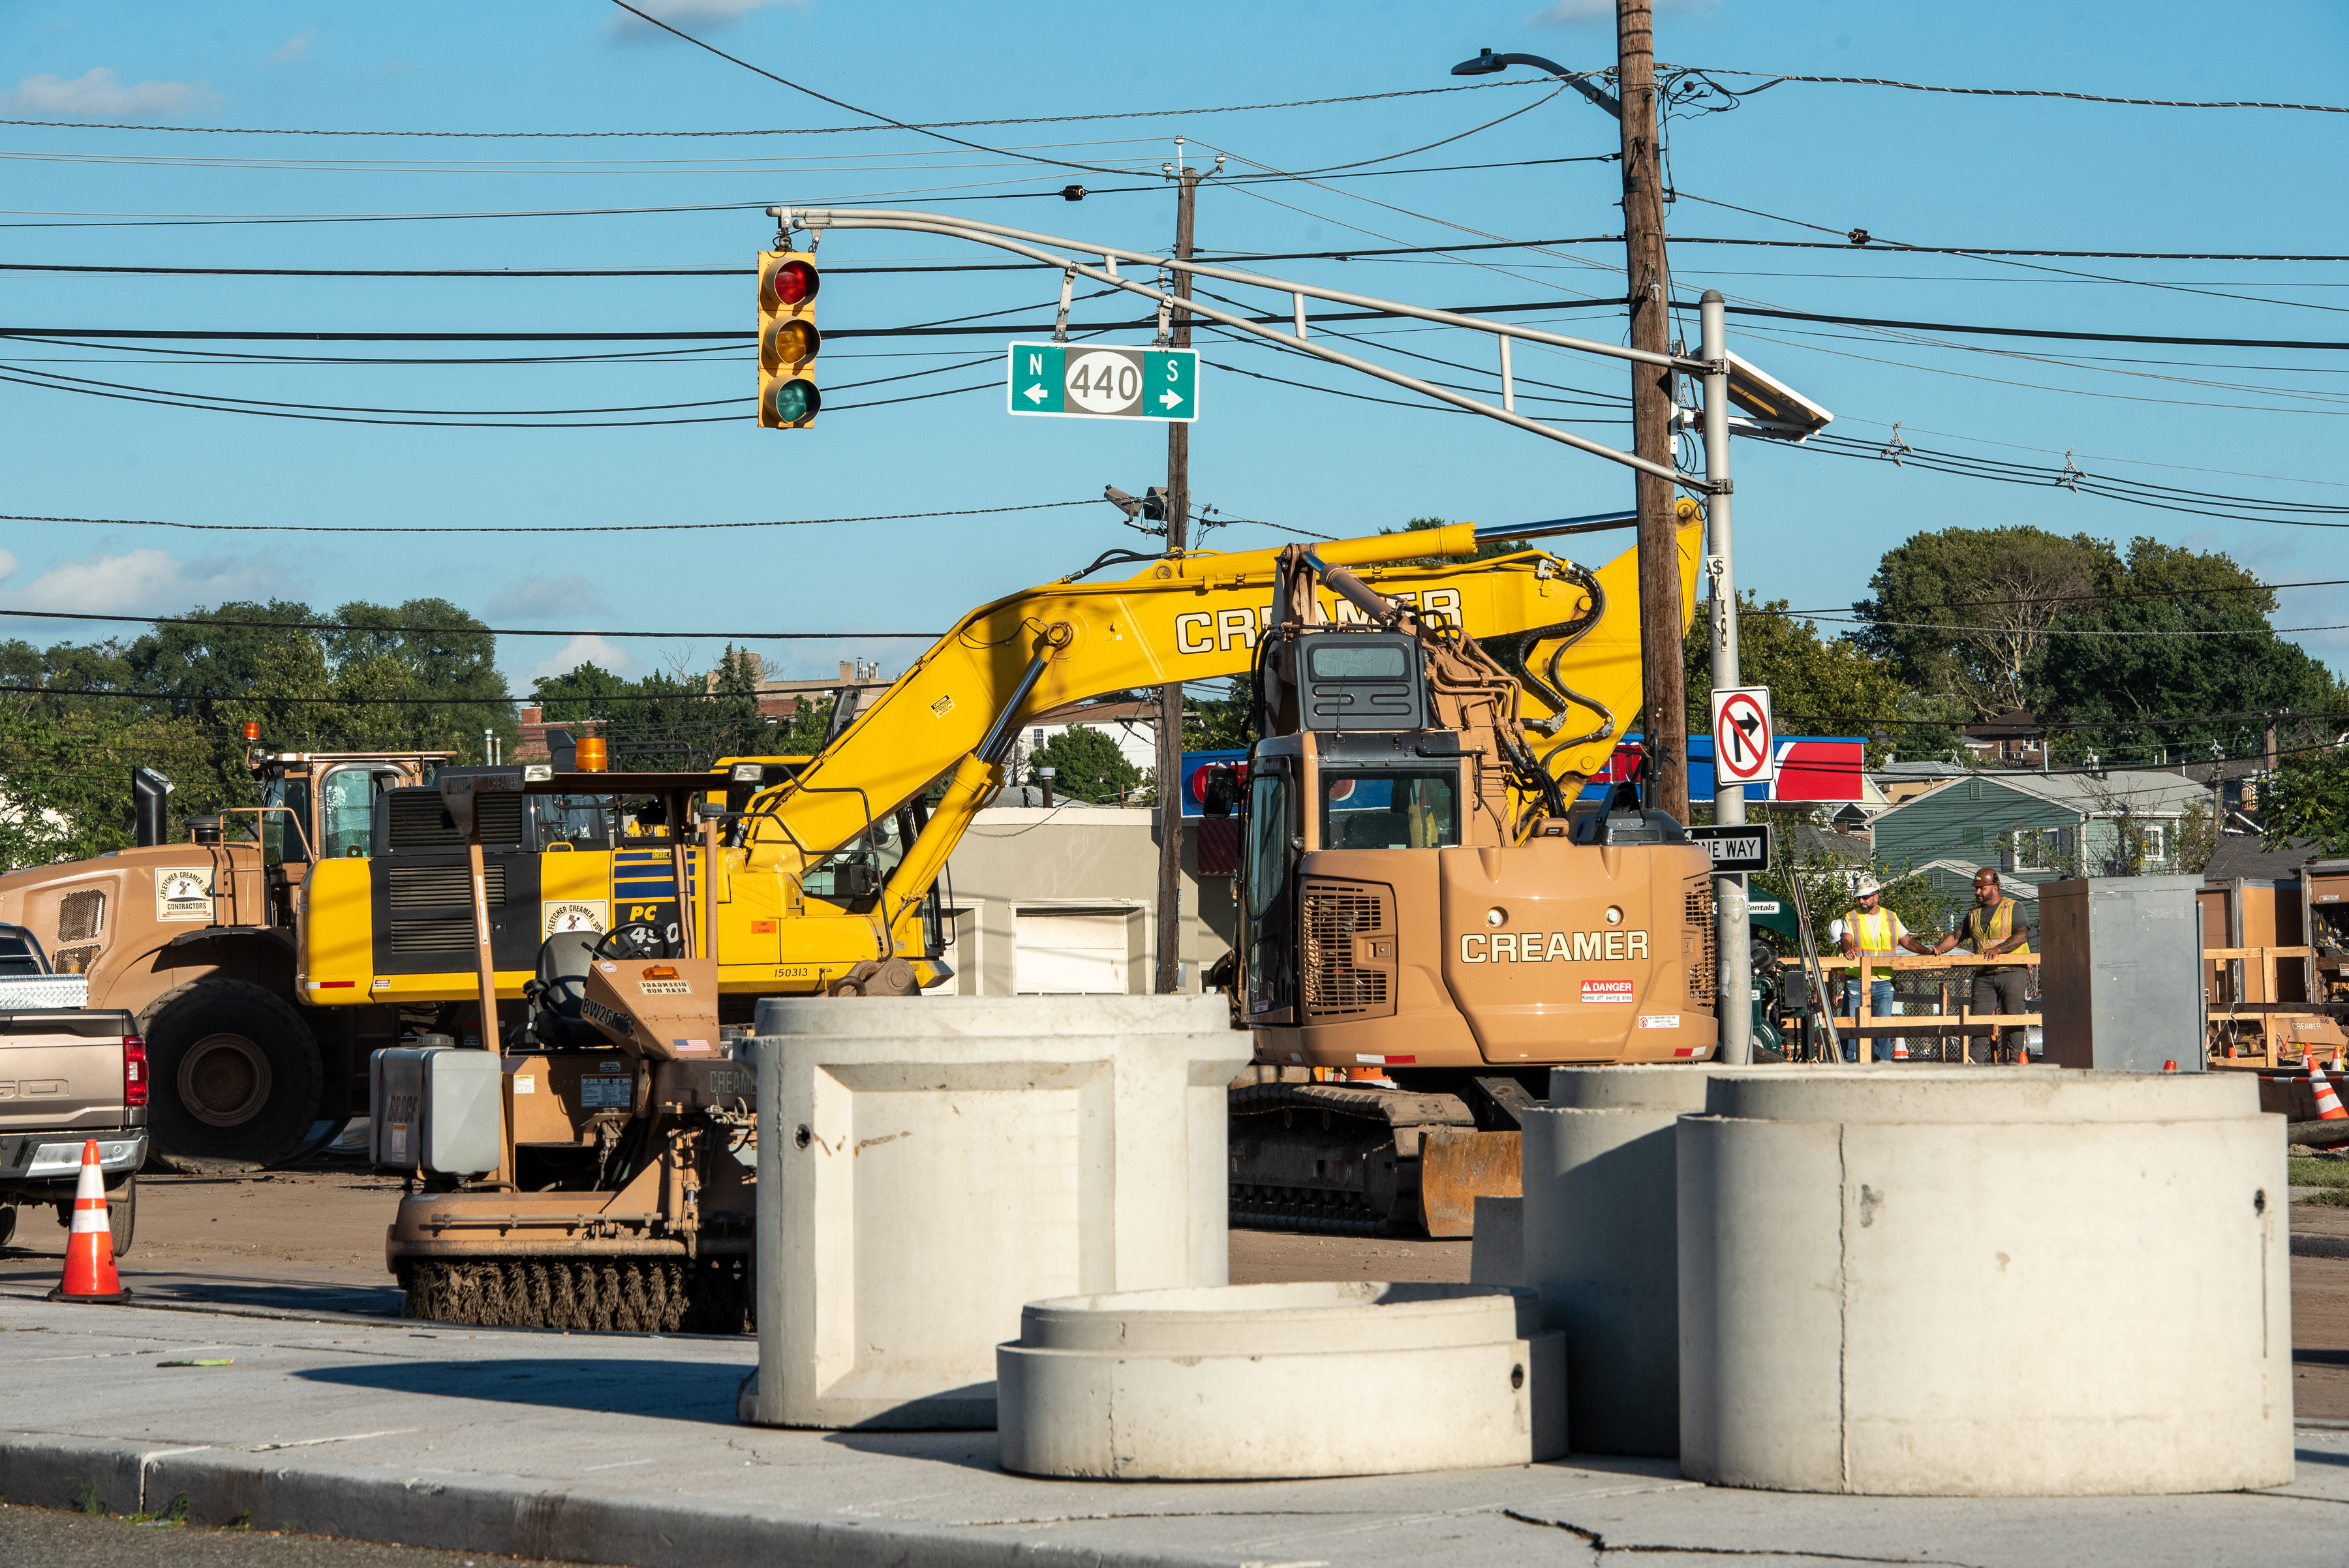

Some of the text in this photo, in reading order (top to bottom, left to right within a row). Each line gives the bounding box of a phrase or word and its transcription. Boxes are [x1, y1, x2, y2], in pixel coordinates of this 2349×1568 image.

[1030, 354, 1178, 401] N 440 S
[488, 775, 519, 790] CREAMER
[1726, 840, 1757, 857] WAY
[179, 871, 204, 885] CREAMER
[569, 905, 594, 919] CREAMER
[592, 921, 604, 933] SON
[630, 906, 657, 921] PC
[1460, 930, 1649, 963] CREAMER
[775, 968, 808, 977] 150313
[1592, 983, 1632, 992] DANGER
[387, 1095, 418, 1124] BROCE
